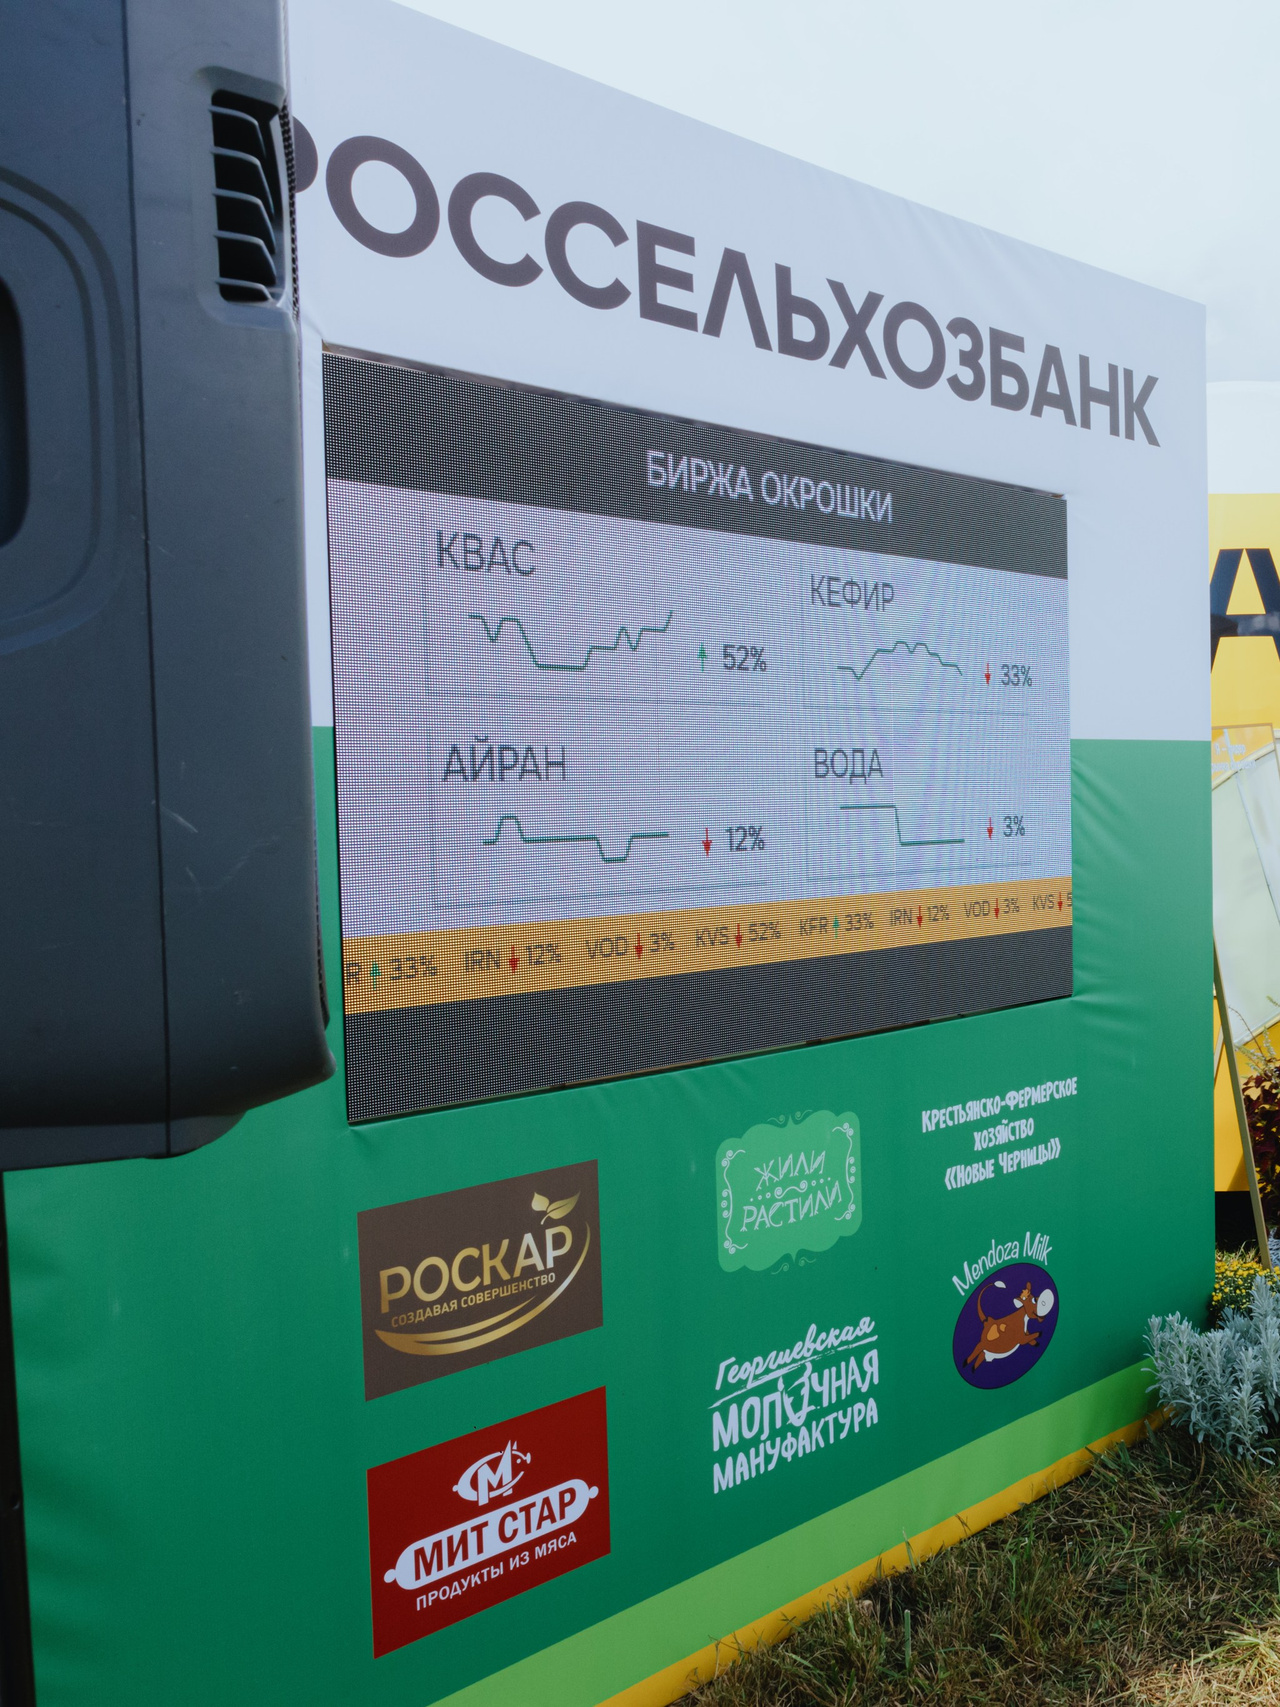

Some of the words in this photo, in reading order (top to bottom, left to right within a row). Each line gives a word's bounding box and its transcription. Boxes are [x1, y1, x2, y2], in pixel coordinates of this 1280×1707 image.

[647, 450, 753, 500] БИРЖА
[761, 471, 892, 523] ОКРОШКИ
[436, 529, 536, 577] КВАС
[810, 573, 894, 612] КЕФИР
[722, 643, 767, 672] 52%
[1001, 664, 1032, 687] 33%
[442, 735, 566, 781] АЙРАН
[814, 748, 884, 784] ВОДА
[726, 825, 765, 852] 12%
[1003, 815, 1025, 837] 3%
[389, 954, 437, 981] 33%
[464, 949, 500, 973] IRN
[526, 943, 561, 967] 12%
[585, 935, 628, 960] VOD
[650, 931, 675, 953] 3%
[695, 926, 729, 948] KVS
[748, 921, 781, 942] 52%
[800, 916, 828, 937] KFR
[845, 911, 874, 932] 33%
[890, 907, 912, 927] IRN
[927, 904, 949, 923] 12%
[963, 900, 990, 919] VOD
[1003, 897, 1020, 914] 3%
[1032, 894, 1055, 911] KVS
[921, 1076, 1078, 1133] КРЕСТЬЯНСКО-ФЕРМЕРСКОЕ
[973, 1117, 1034, 1152] ХОЗЯЙСТВО
[754, 1150, 826, 1192] ЖИЛИ
[740, 1180, 842, 1233] РАСТИЛИ
[379, 1225, 573, 1314] РОСКАР
[951, 1238, 1019, 1296] Mendoza
[1023, 1231, 1053, 1266] Milk
[391, 1299, 458, 1328] СОЗДАВАЯ
[461, 1272, 556, 1308] СОВЕРШЕНСТВО
[715, 1316, 875, 1390] Георгиевская
[713, 1398, 879, 1495] МАНУФАКТУРА
[413, 1519, 488, 1582] МИТ
[499, 1487, 577, 1544] СТАР
[416, 1564, 504, 1611] ПРОДУКТЫ
[510, 1549, 531, 1569] ИЗ
[535, 1531, 577, 1560] МЯСА
